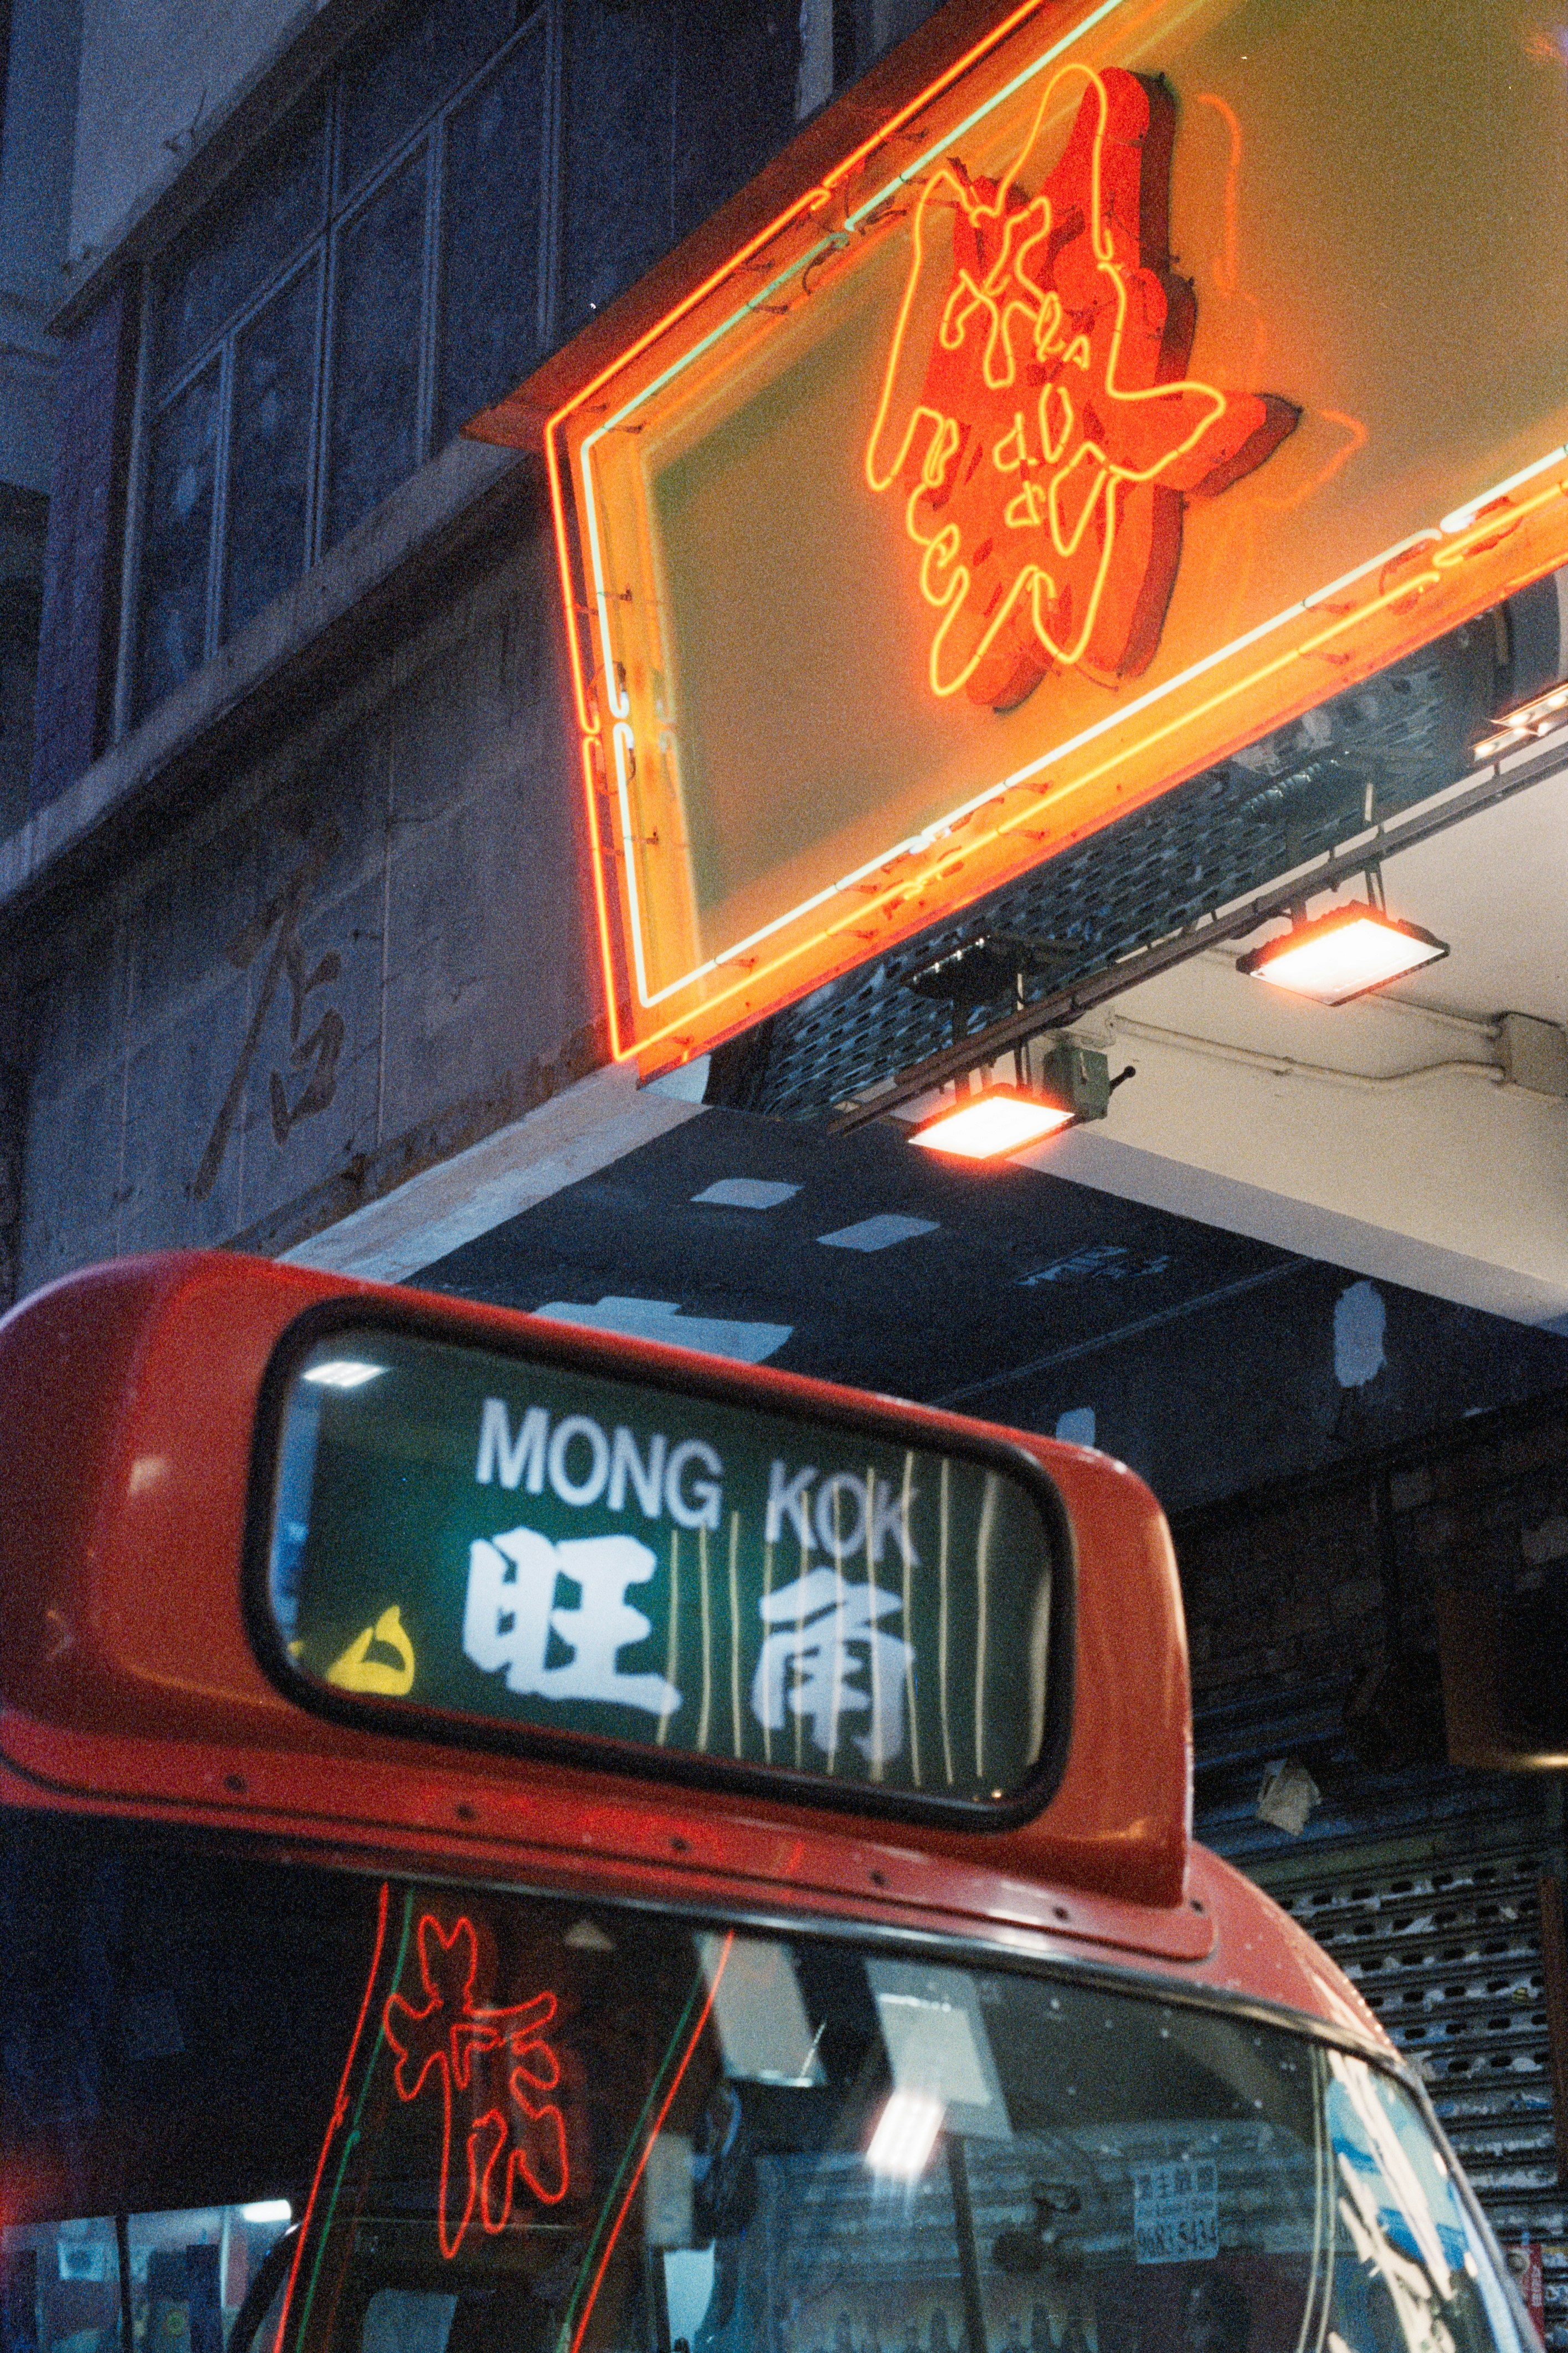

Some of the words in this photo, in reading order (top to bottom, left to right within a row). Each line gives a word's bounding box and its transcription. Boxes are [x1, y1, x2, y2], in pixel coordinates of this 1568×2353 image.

[476, 1398, 722, 1530] MONG
[765, 1459, 922, 1567] KOK
[464, 1526, 914, 1761] 旺角
